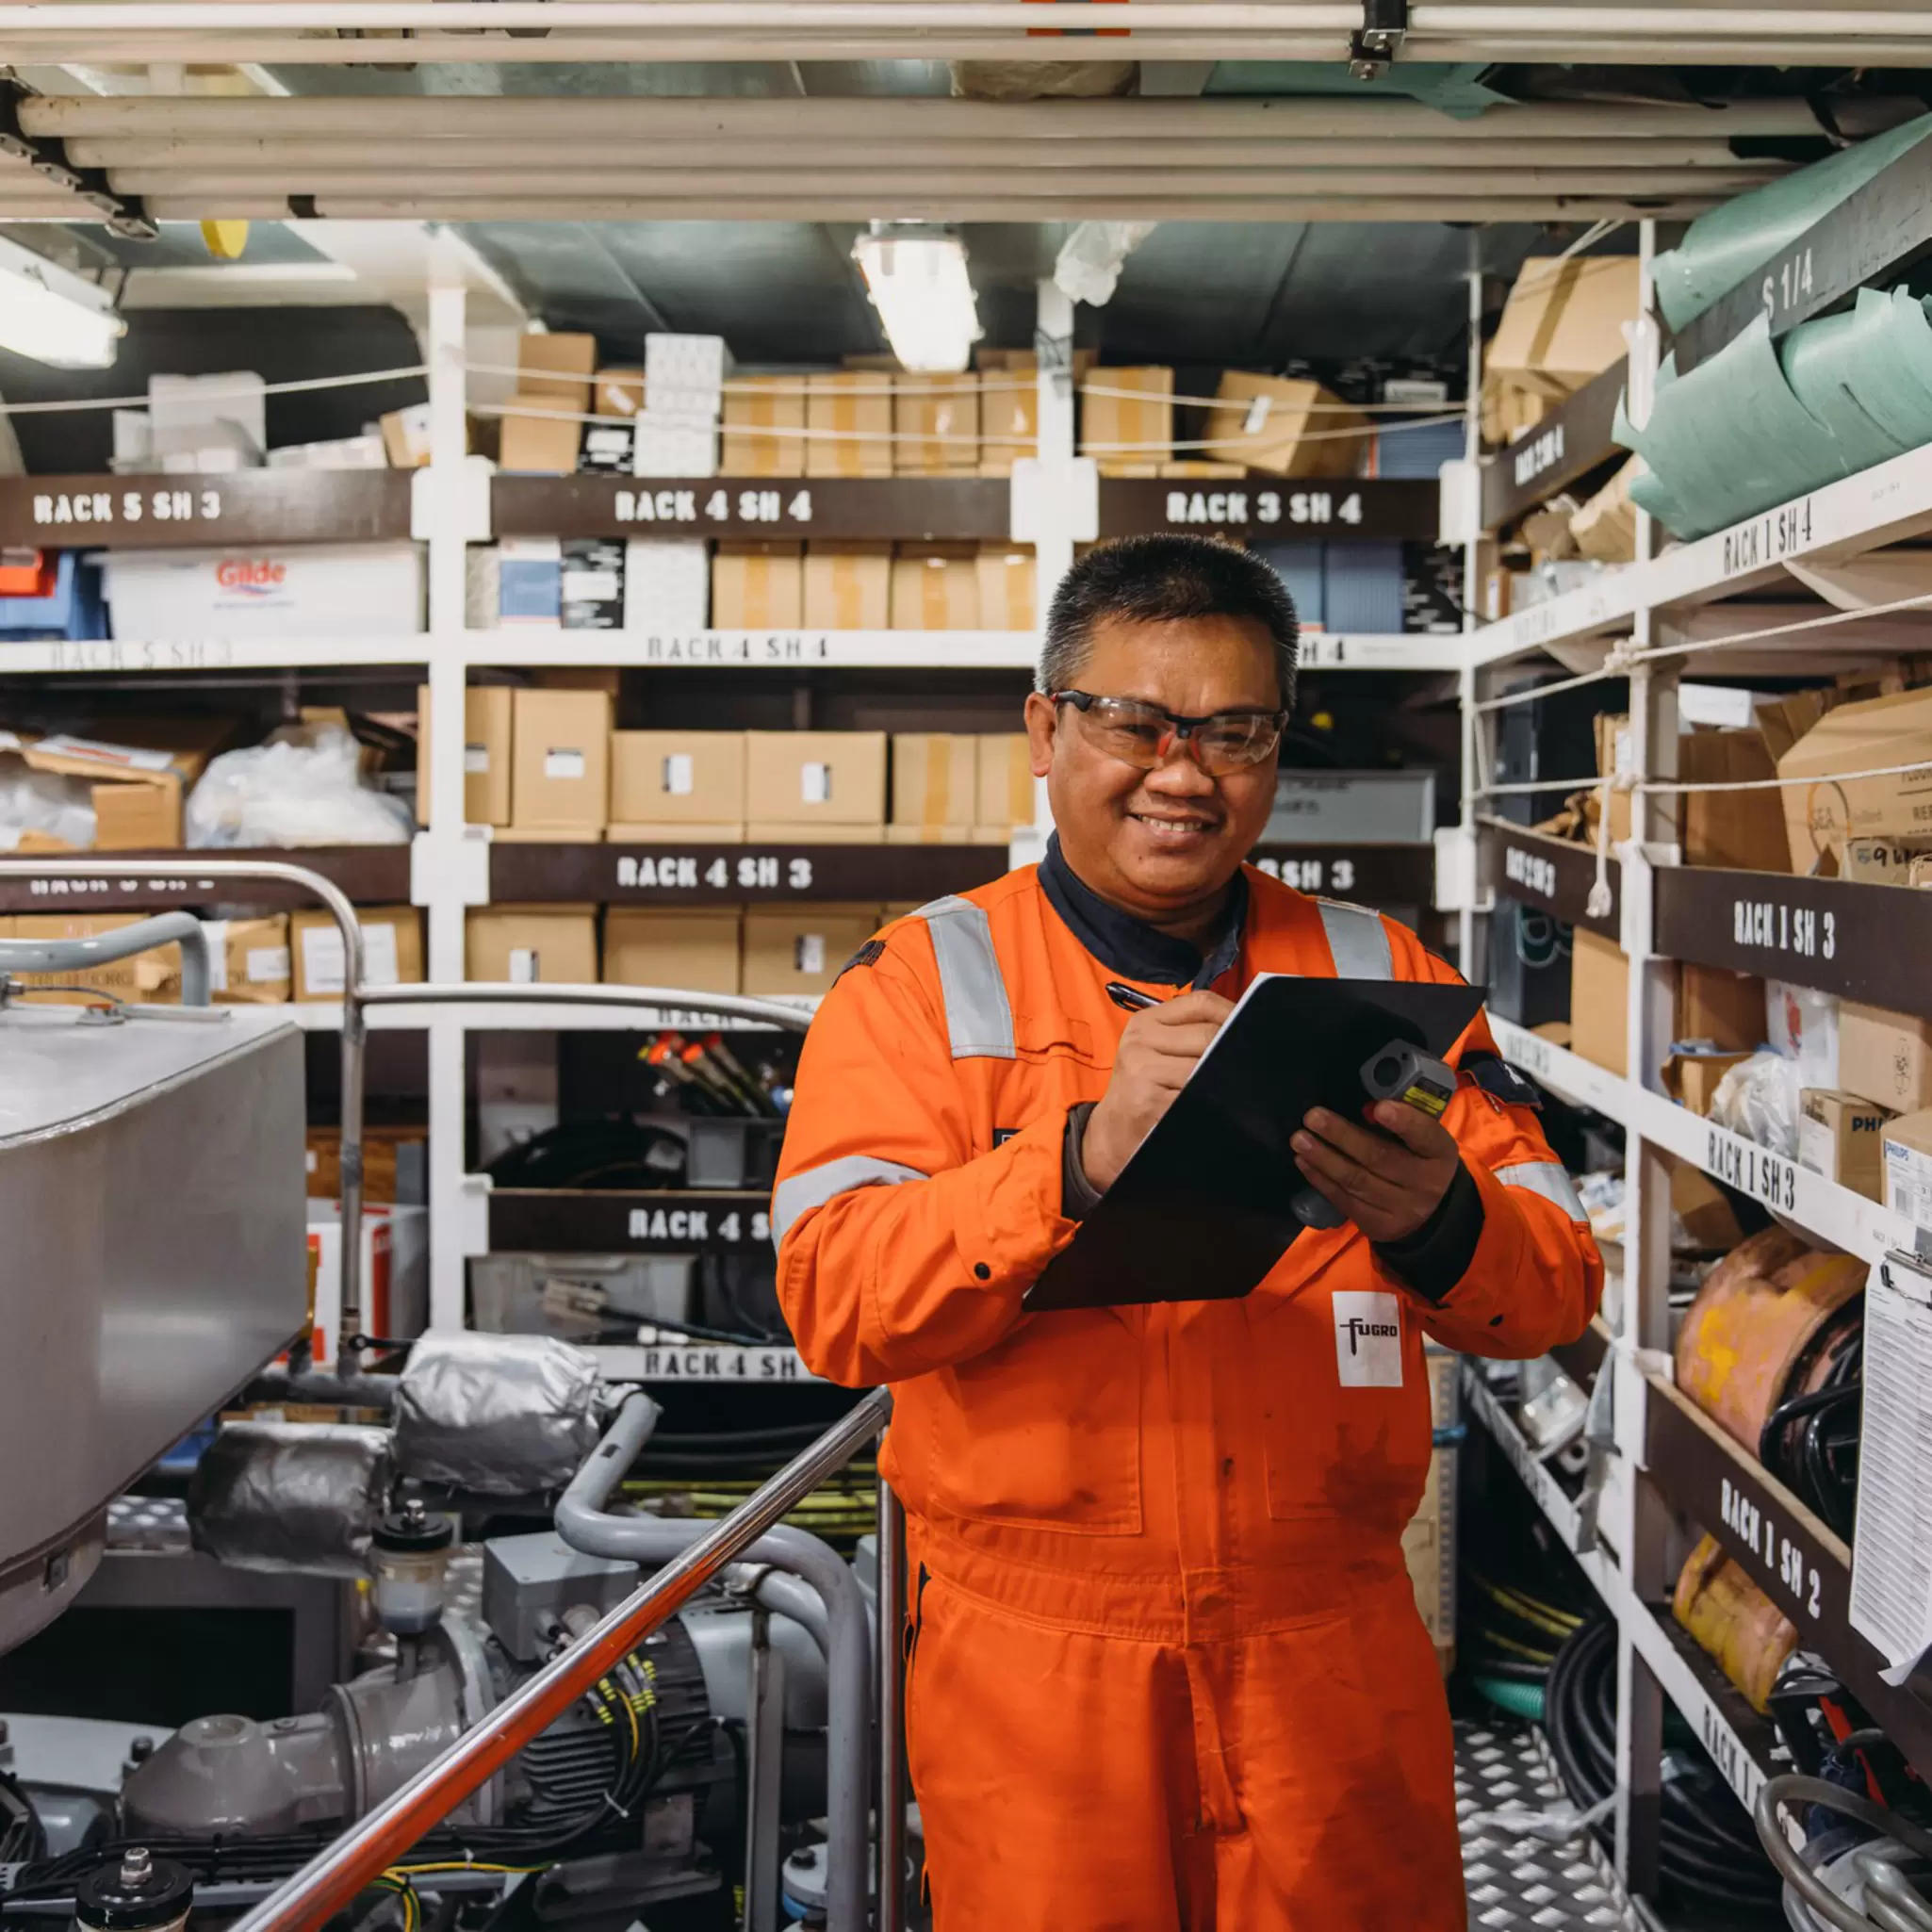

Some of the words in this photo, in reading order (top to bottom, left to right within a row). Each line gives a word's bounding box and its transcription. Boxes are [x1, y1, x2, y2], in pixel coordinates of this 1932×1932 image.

[1762, 275, 1775, 318] S
[1781, 248, 1813, 311] 1/4
[33, 493, 113, 524] RACK
[123, 492, 142, 521] 5
[152, 490, 192, 520] SH
[201, 491, 221, 520] 3
[614, 490, 696, 522] RACK
[705, 489, 729, 521] 4
[739, 491, 780, 522] SH
[788, 489, 812, 522] 4
[1166, 491, 1249, 524] RACK
[1257, 491, 1282, 523] 3
[1289, 492, 1332, 524] SH
[1337, 492, 1363, 525] 4
[1724, 524, 1759, 576] RACK
[1763, 518, 1771, 560] 1
[1778, 507, 1797, 553] SH
[1801, 496, 1811, 542] 4
[216, 559, 287, 588] Gilde
[647, 637, 723, 660] RACK
[732, 637, 750, 660] 4
[765, 637, 801, 660] SH
[810, 637, 828, 659] 4
[1302, 641, 1318, 663] H
[1327, 638, 1345, 662] 4
[616, 857, 697, 887] RACK
[705, 857, 729, 888] 4
[737, 857, 779, 888] SH
[788, 858, 813, 889] 3
[1282, 860, 1323, 890] SH
[1331, 859, 1355, 891] 3
[1734, 900, 1774, 947] RACK
[1778, 905, 1788, 950] 1
[1793, 909, 1815, 957] SH
[1823, 911, 1835, 959] 3
[1852, 1116, 1883, 1132] PHI
[1709, 1130, 1742, 1189] RACK
[1749, 1151, 1755, 1193] 1
[1761, 1156, 1780, 1204] SH
[1785, 1167, 1794, 1211] 3
[629, 1208, 709, 1240] RACK
[717, 1211, 741, 1242] 4
[751, 1211, 771, 1241] S
[646, 1352, 720, 1376] RACK
[729, 1353, 746, 1376] 4
[761, 1354, 796, 1377] SH
[1721, 1477, 1760, 1555] RACK
[1765, 1520, 1775, 1569] 1
[1780, 1538, 1803, 1598] SH
[1808, 1568, 1821, 1619] 2
[1704, 1704, 1737, 1791] RACK
